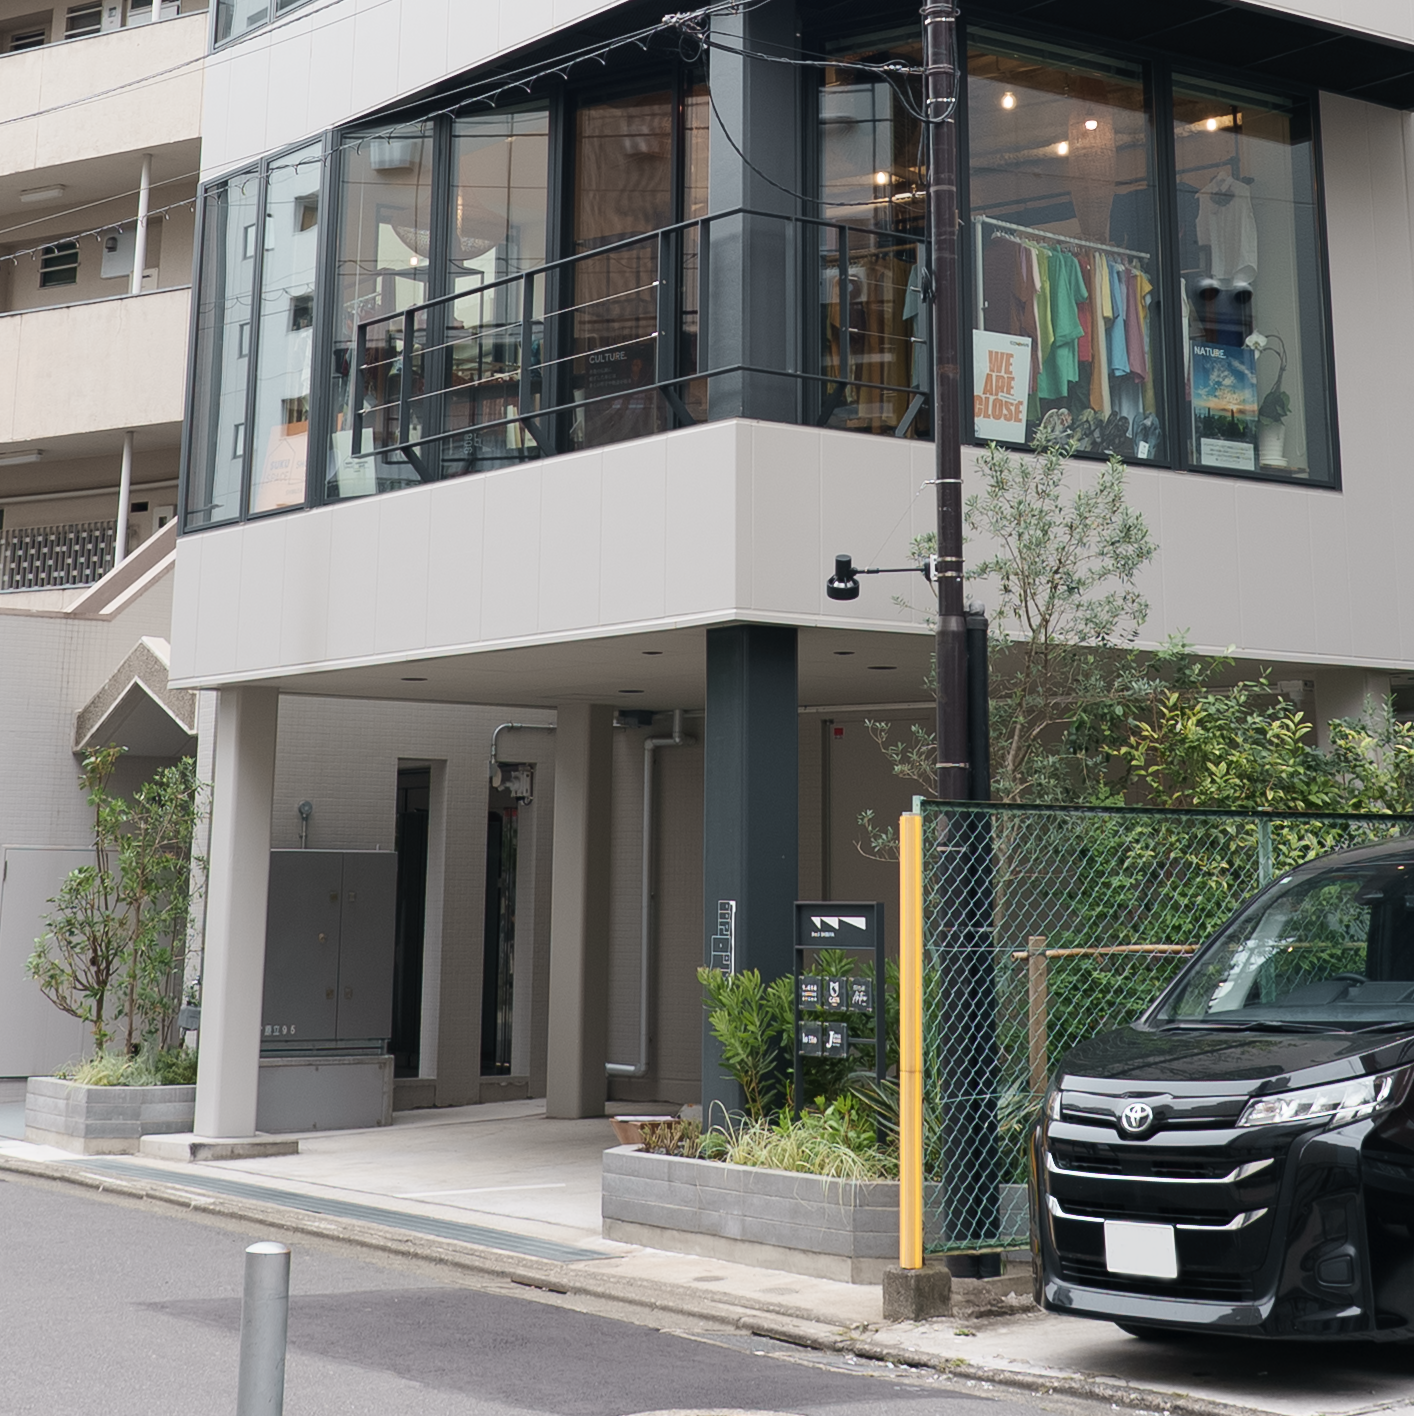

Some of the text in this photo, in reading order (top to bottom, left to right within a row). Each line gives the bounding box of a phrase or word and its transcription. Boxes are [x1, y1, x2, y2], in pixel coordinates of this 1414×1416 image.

[988, 349, 1014, 375] WE
[982, 373, 1015, 396] ARE
[974, 394, 1024, 424] CLOSE
